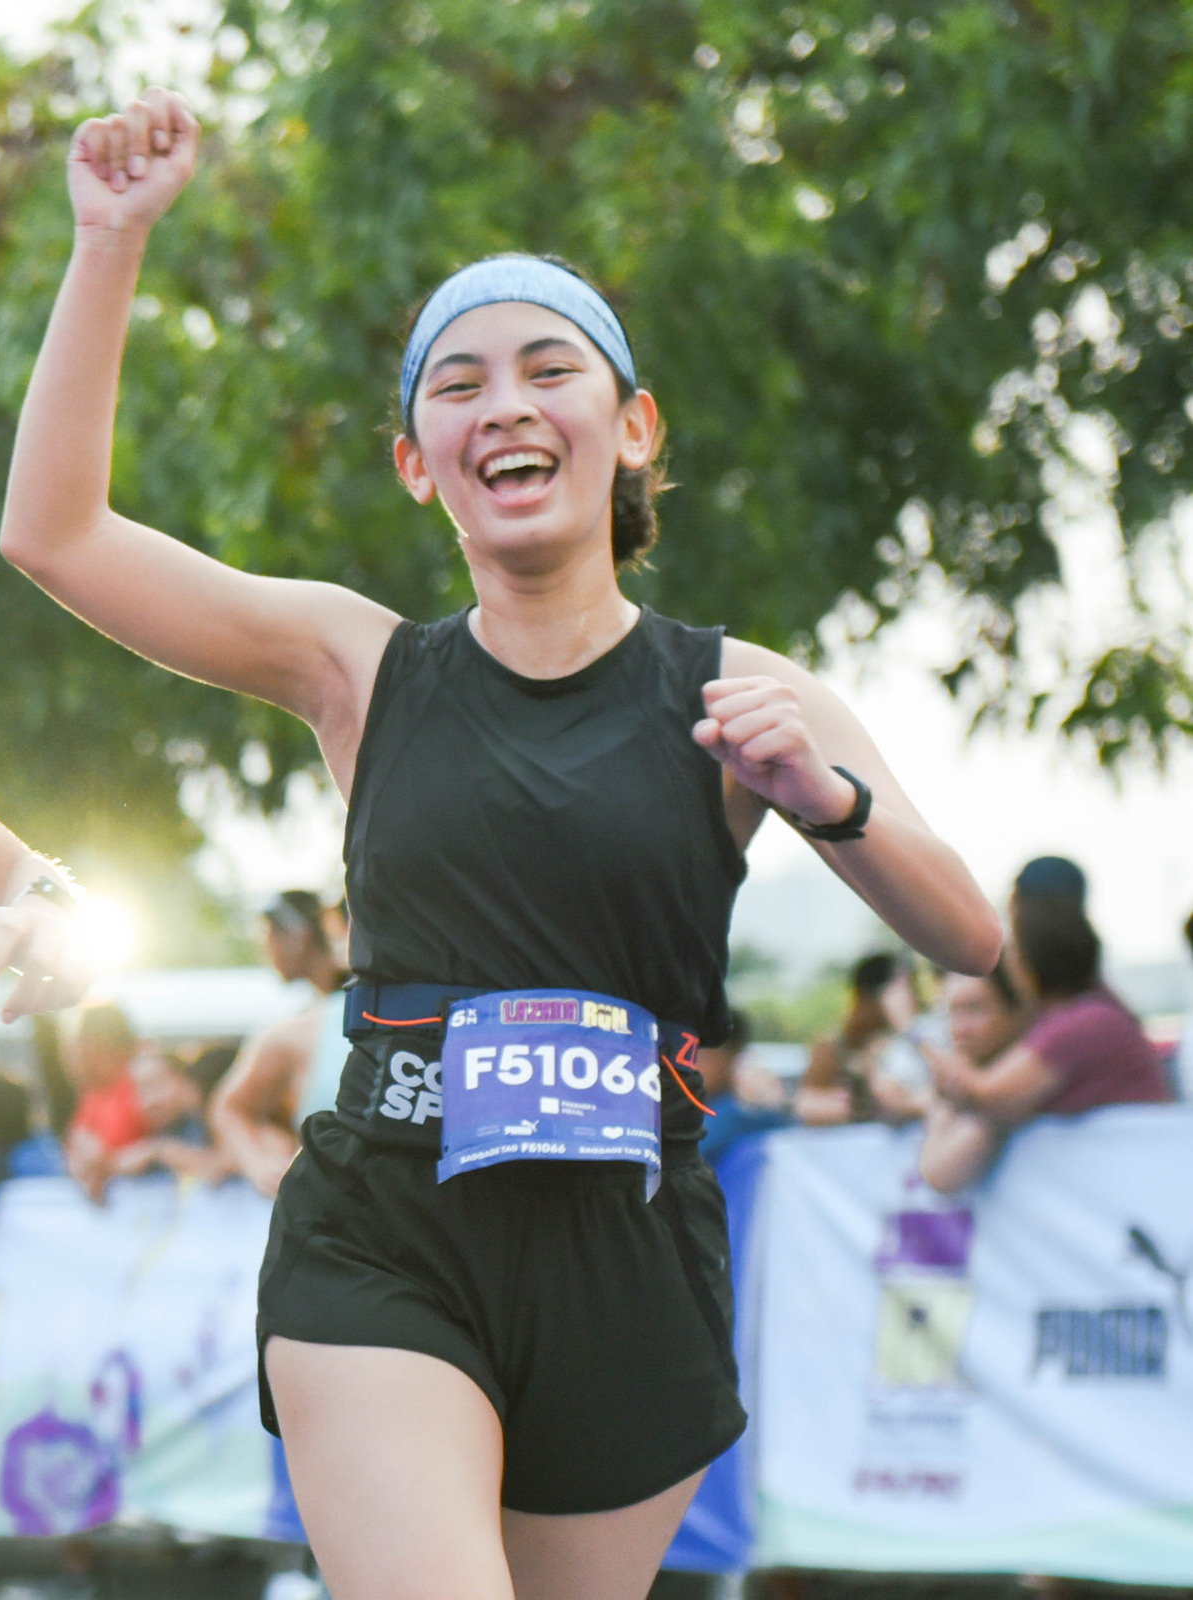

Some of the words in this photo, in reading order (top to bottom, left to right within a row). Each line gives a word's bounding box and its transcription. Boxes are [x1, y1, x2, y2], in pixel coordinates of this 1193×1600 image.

[501, 998, 579, 1024] LAZADA
[465, 1045, 661, 1102] F51066
[521, 1142, 566, 1154] F51066
